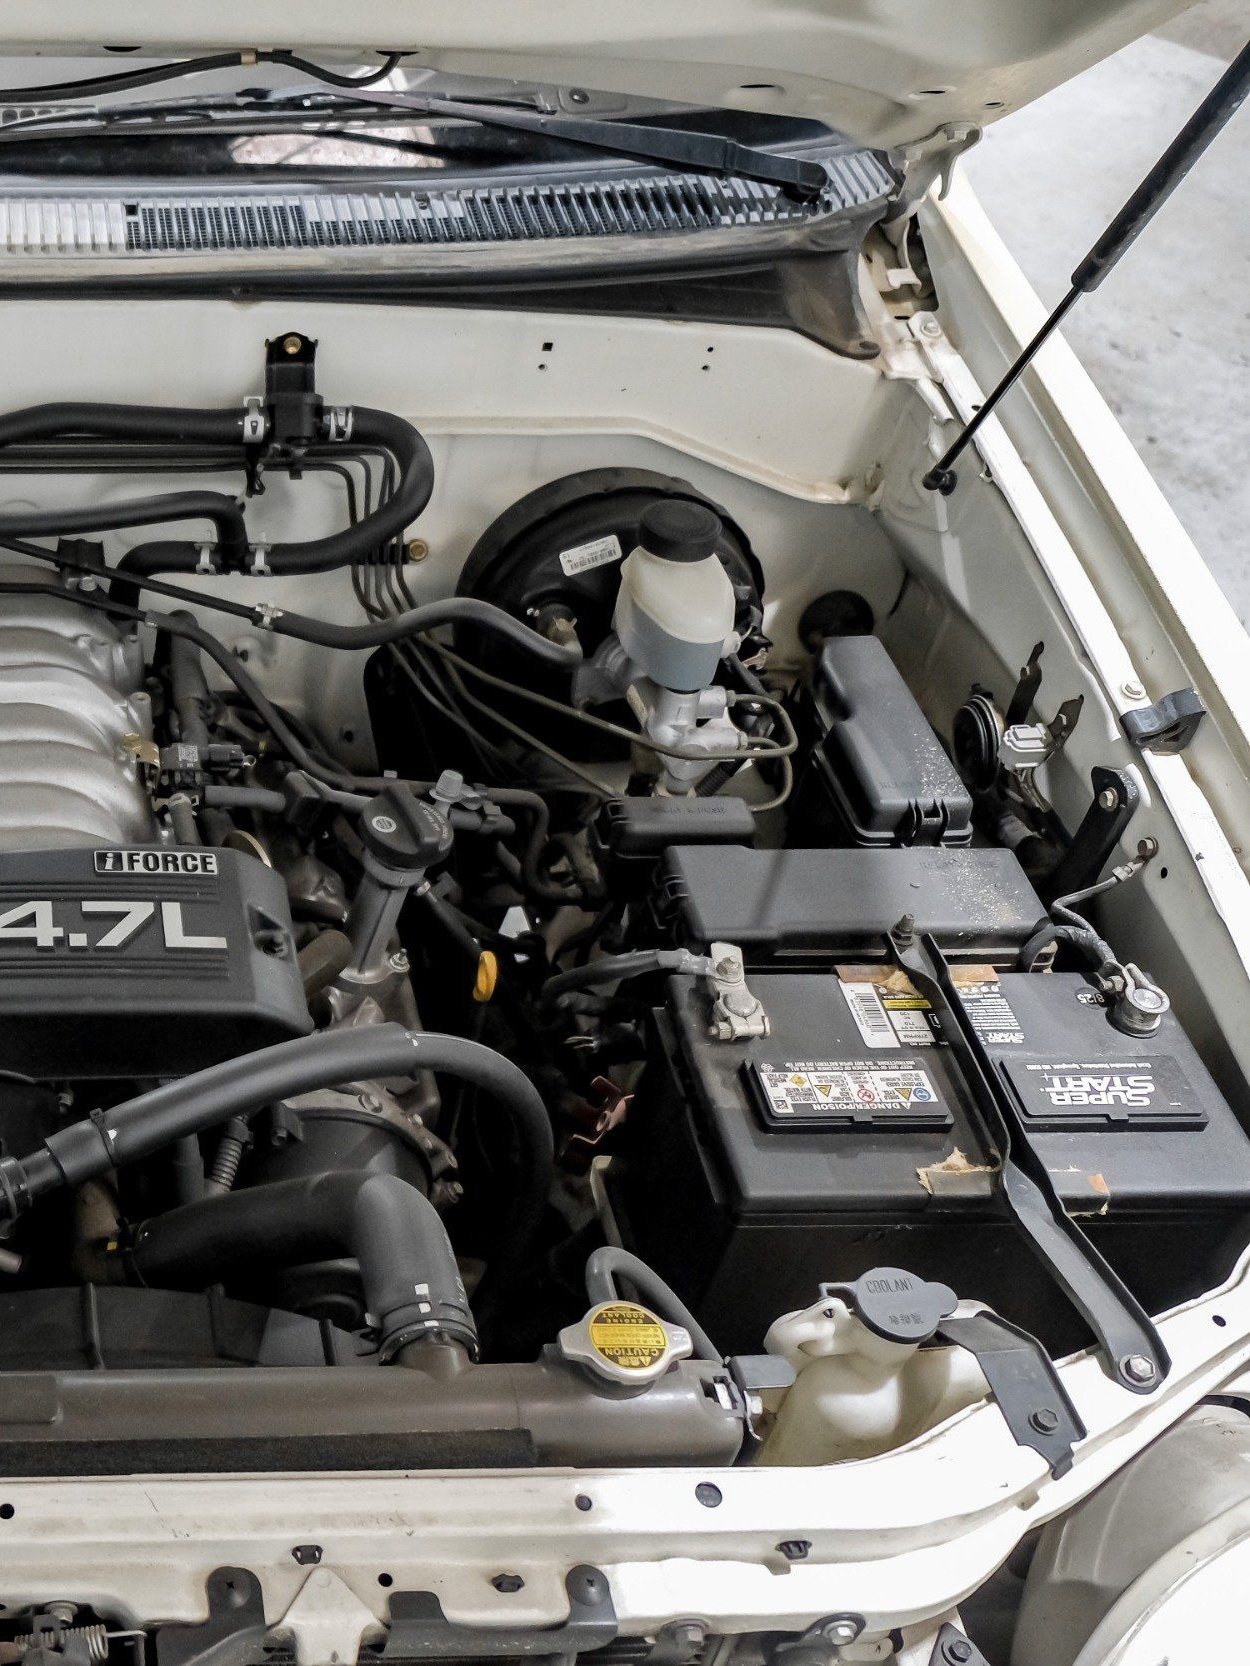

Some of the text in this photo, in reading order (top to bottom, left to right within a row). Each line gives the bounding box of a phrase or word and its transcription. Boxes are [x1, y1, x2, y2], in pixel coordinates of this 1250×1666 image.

[127, 852, 216, 874] FORCE
[1077, 993, 1105, 1003] 8/25
[1044, 1075, 1155, 1092] START
[812, 1102, 900, 1110] DANGER/POISON
[1049, 1091, 1150, 1106] SUPER
[865, 1277, 914, 1294] COOLANT
[604, 1348, 659, 1356] CAUTION
